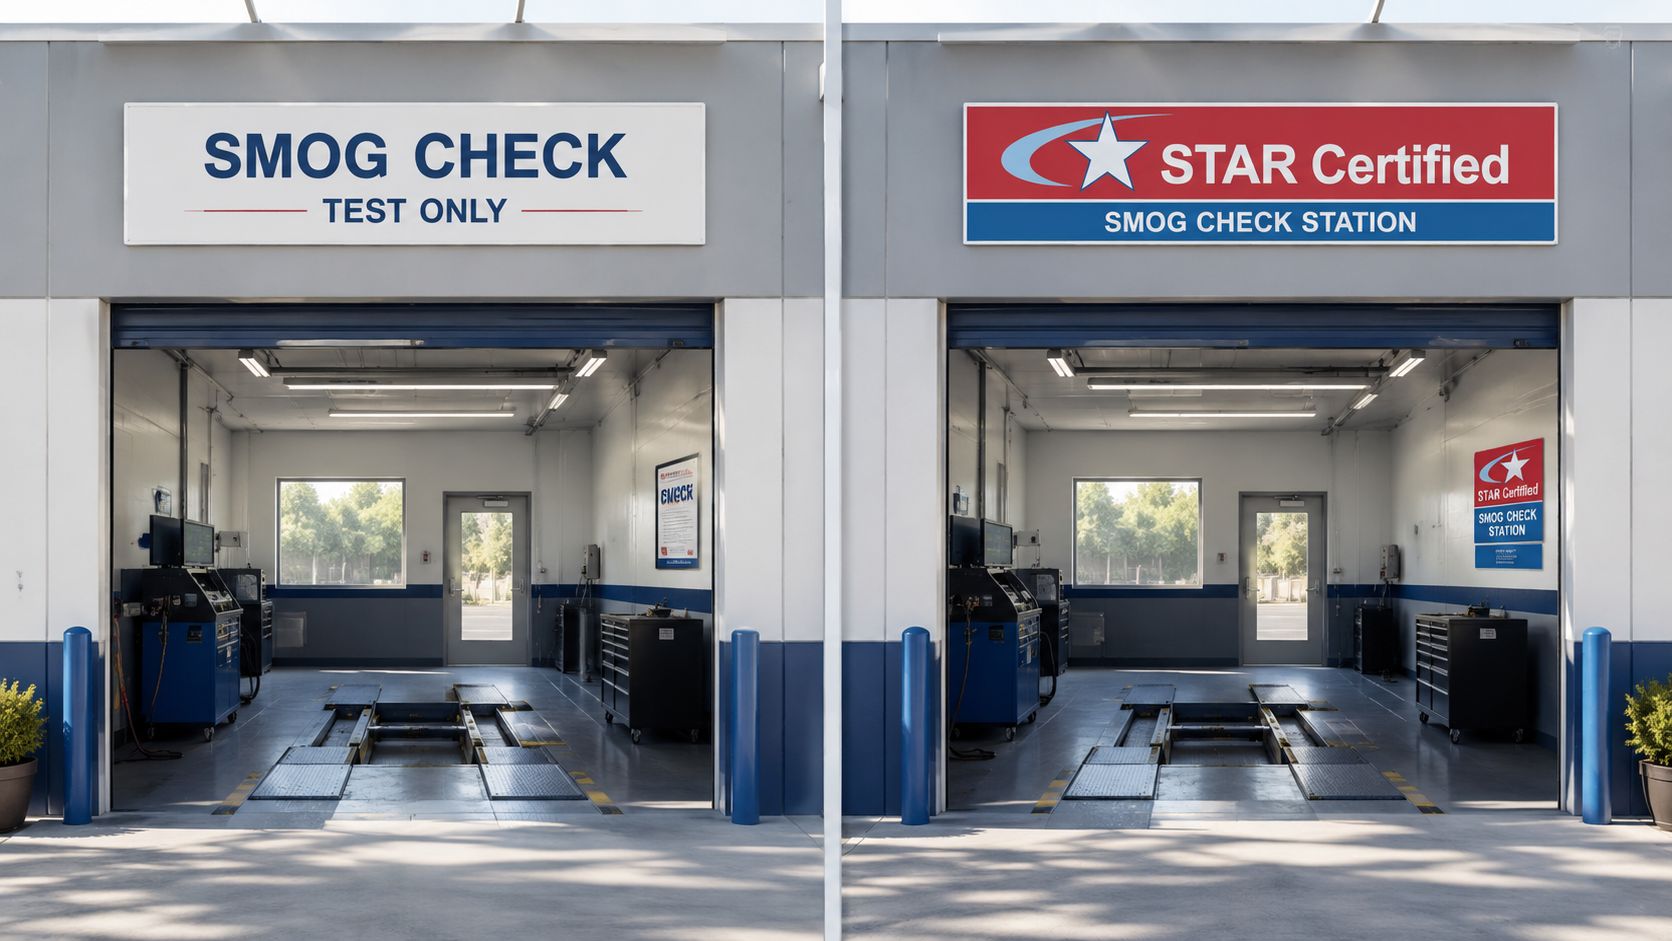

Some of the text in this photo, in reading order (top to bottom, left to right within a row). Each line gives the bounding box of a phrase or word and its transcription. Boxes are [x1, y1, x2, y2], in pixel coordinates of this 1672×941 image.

[204, 132, 627, 180] SMOG CHECK
[1160, 143, 1510, 185] STAR Certified
[322, 197, 508, 224] TEST ONLY
[1104, 211, 1417, 233] SMOG CHECK STATION
[1478, 488, 1500, 502] STAR
[1478, 508, 1537, 524] SMOG CHECK
[1488, 525, 1526, 537] STATION
